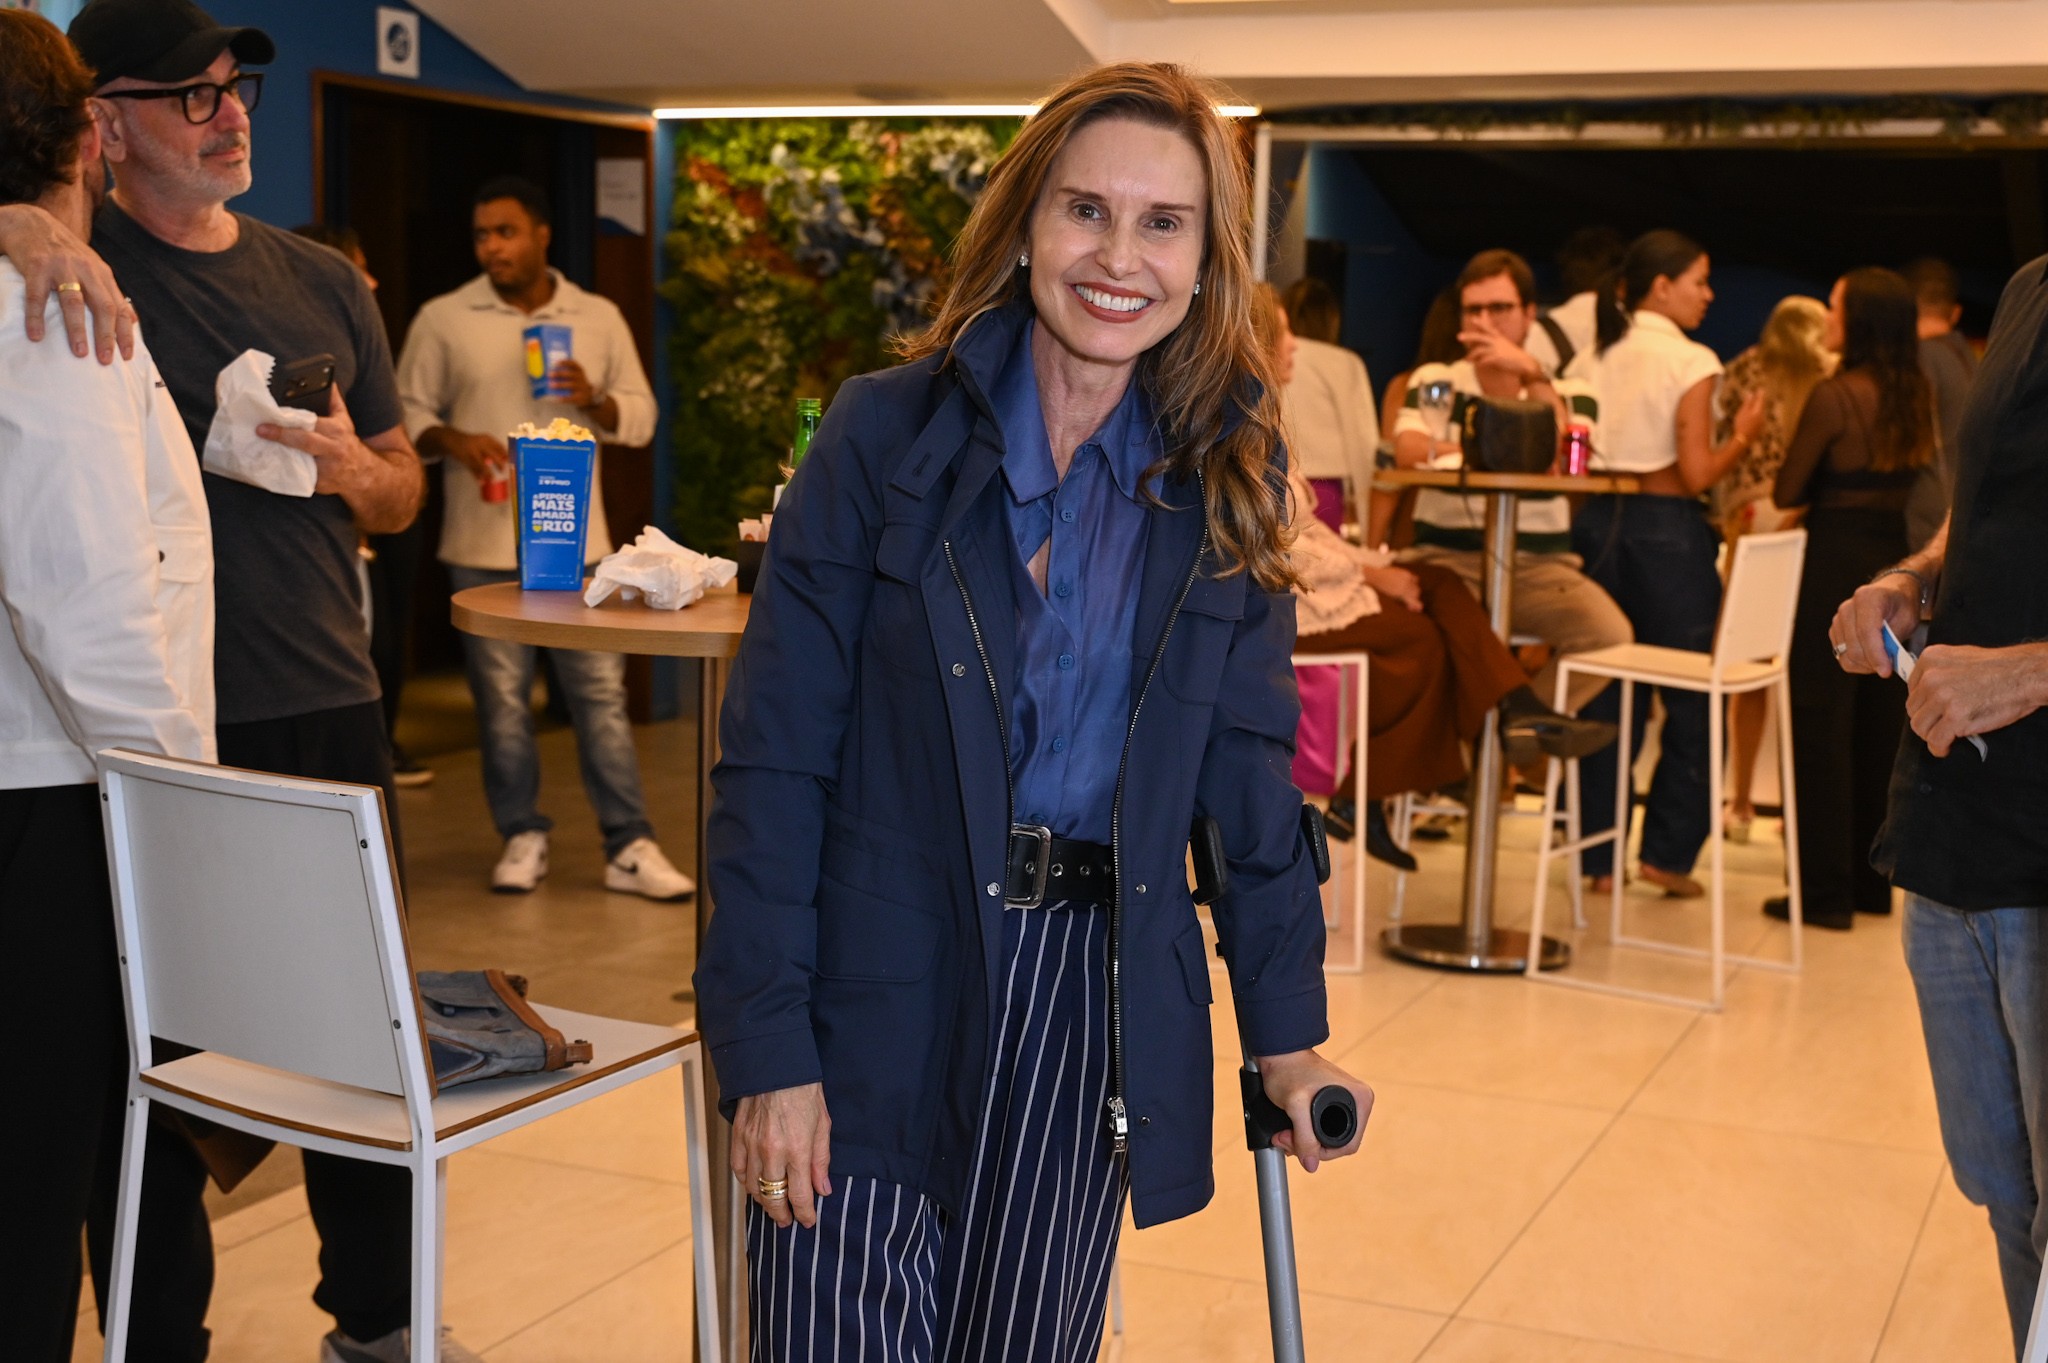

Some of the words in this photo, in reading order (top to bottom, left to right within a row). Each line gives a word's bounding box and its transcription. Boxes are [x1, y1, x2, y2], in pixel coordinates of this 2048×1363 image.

[538, 492, 575, 500] PIPOCA
[532, 499, 575, 511] MAIS
[532, 510, 576, 519] AMADA
[542, 519, 575, 533] RIO
